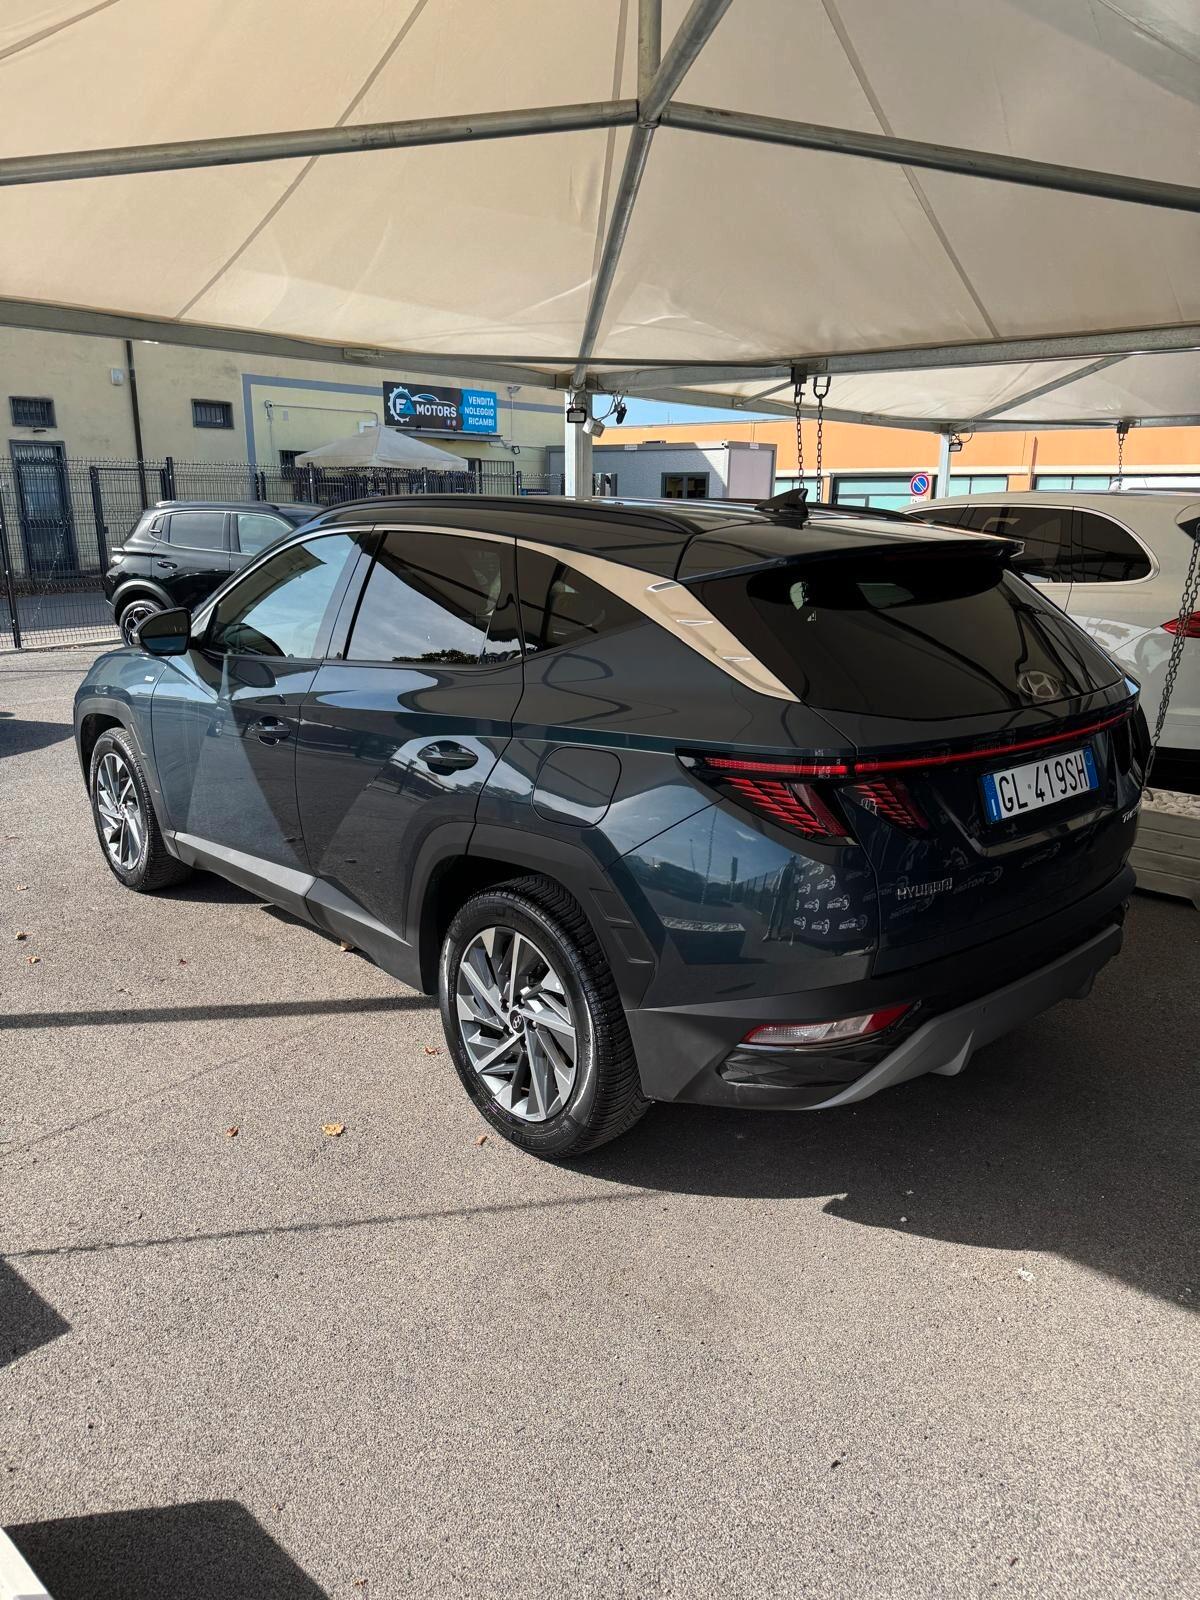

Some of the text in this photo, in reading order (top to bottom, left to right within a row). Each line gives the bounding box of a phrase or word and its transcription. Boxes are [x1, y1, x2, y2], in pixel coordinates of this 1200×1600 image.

[468, 395, 495, 406] VENDITA
[416, 404, 457, 418] MOTORS
[464, 406, 495, 417] NOLEGGIO
[468, 417, 495, 426] RICAMBI
[998, 754, 1089, 812] GL 419SH
[897, 877, 953, 901] HYUNDAI
